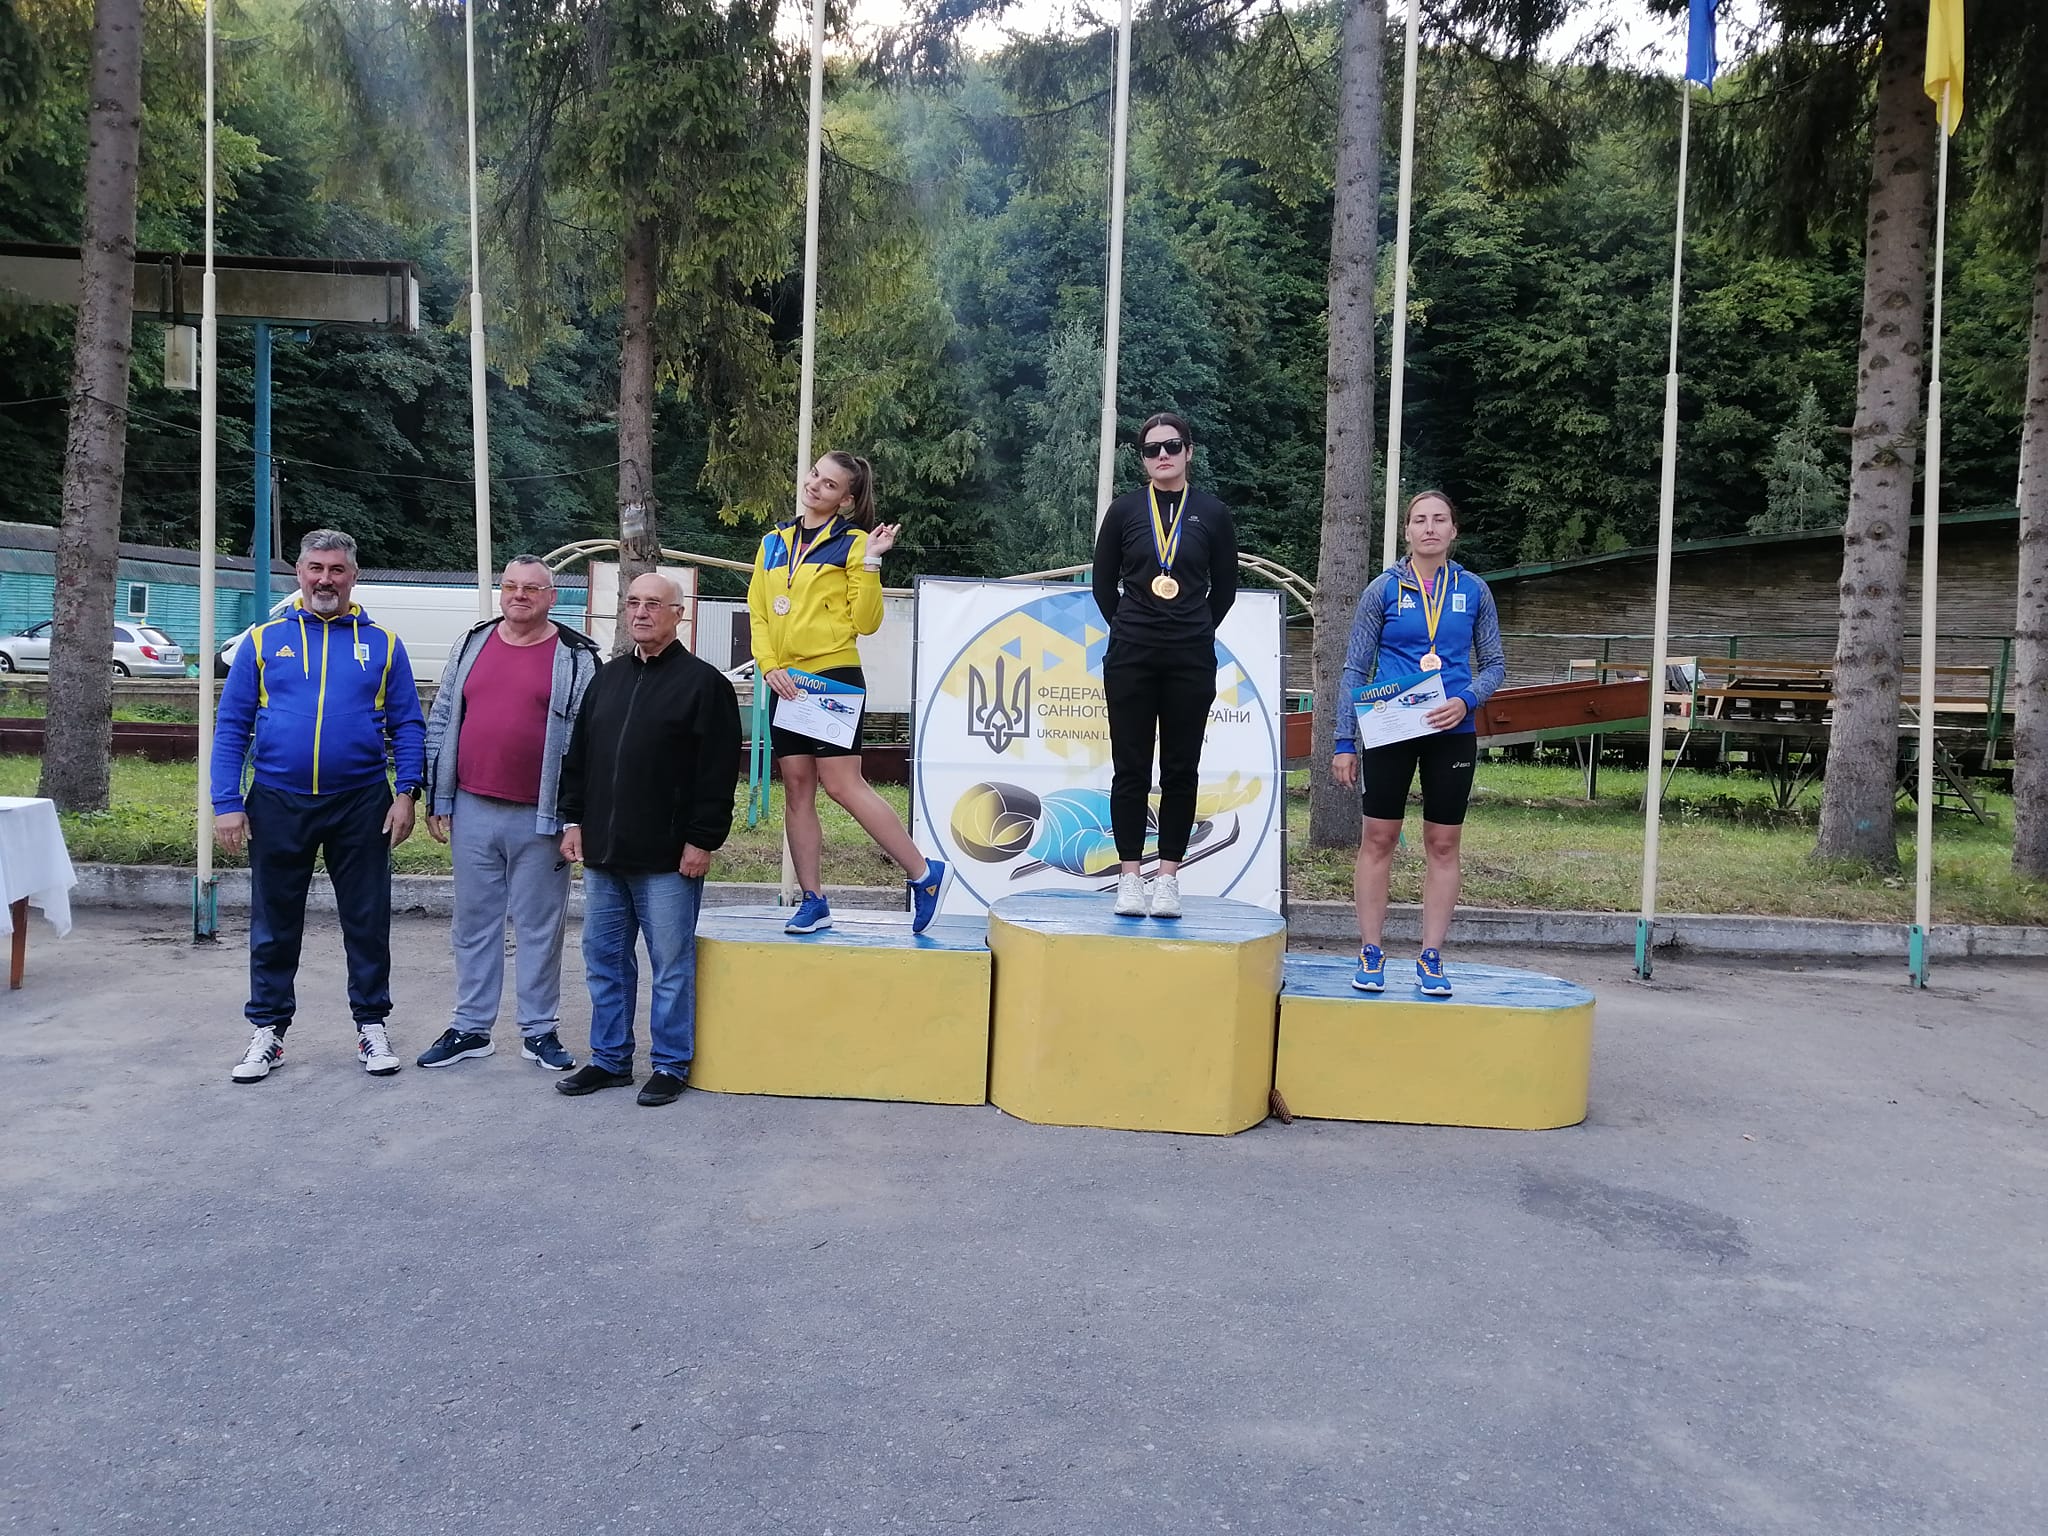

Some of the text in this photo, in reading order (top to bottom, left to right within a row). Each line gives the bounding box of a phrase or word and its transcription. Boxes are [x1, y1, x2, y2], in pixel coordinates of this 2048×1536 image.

[1360, 682, 1400, 701] ДИПЛОМ
[1207, 708, 1251, 723] РАЇНИ
[1037, 728, 1099, 740] UKRAINIAN
